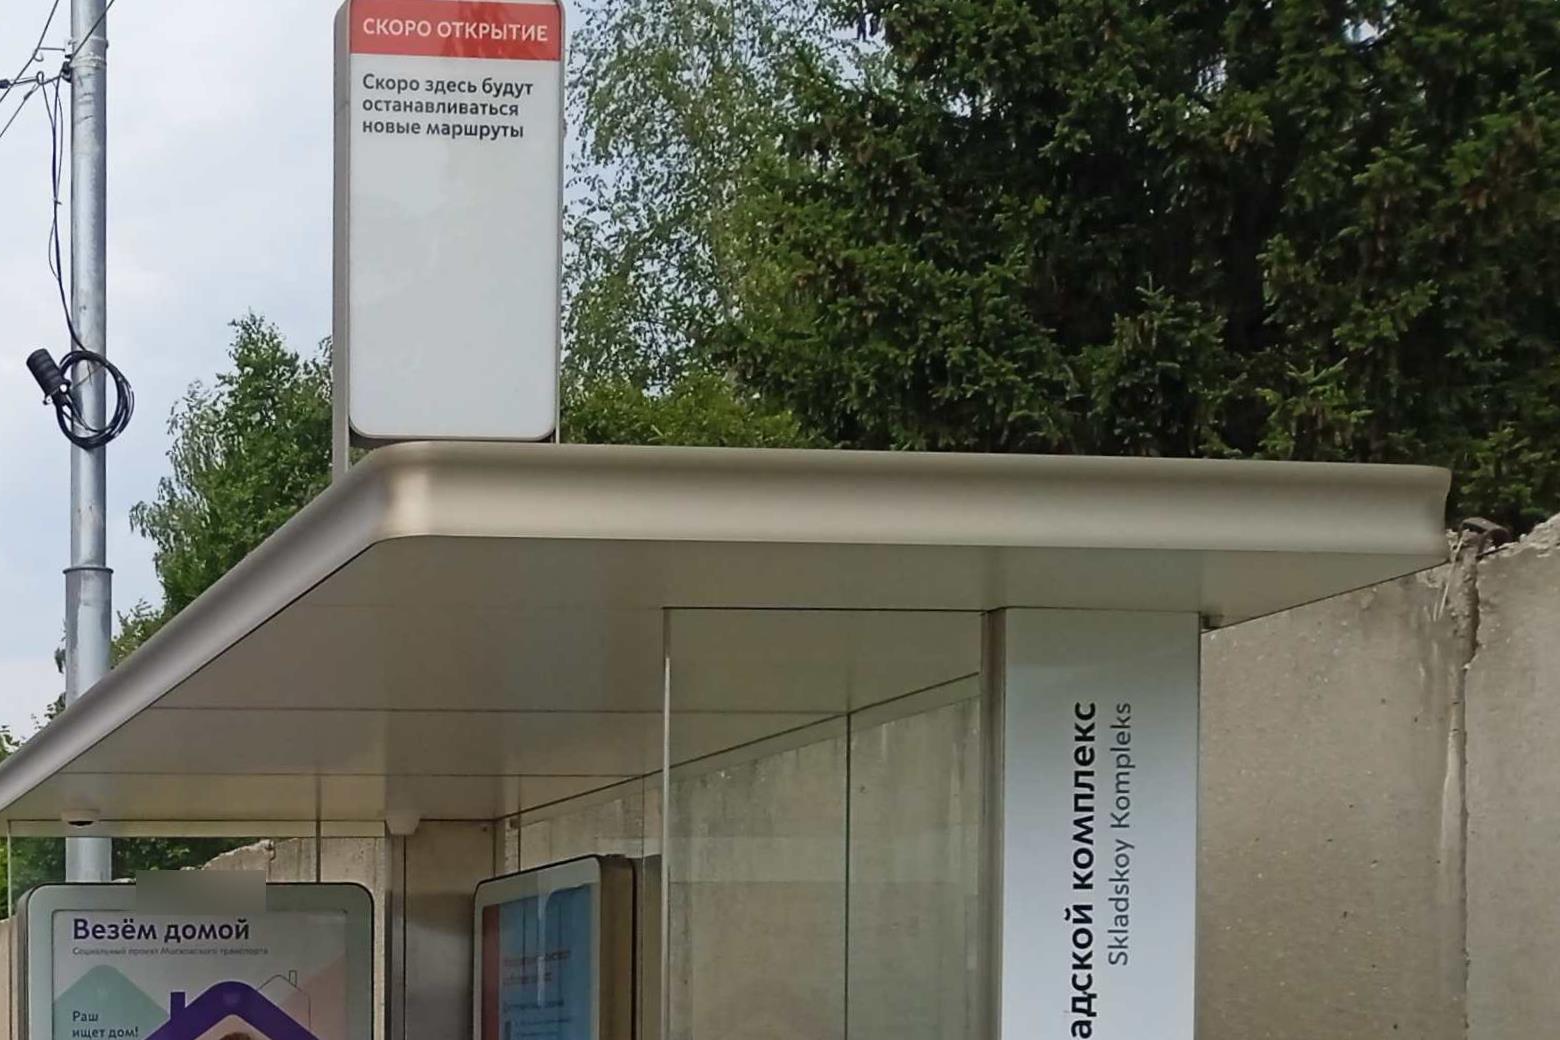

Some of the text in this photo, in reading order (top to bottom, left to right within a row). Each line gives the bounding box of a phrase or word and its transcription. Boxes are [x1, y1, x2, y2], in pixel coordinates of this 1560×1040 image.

[362, 18, 549, 42] СКОРО ОТКРЫТИЕ
[362, 73, 534, 99] Скоро здесь будут
[362, 99, 519, 116] останавливаться
[362, 121, 524, 141] новые маршруты
[1072, 702, 1096, 890] комплекс
[1108, 703, 1136, 966] Skladskoy Kompleks
[72, 918, 250, 943] Везём домой
[72, 1010, 99, 1022] Раш
[72, 1026, 139, 1040] ищет дом!
